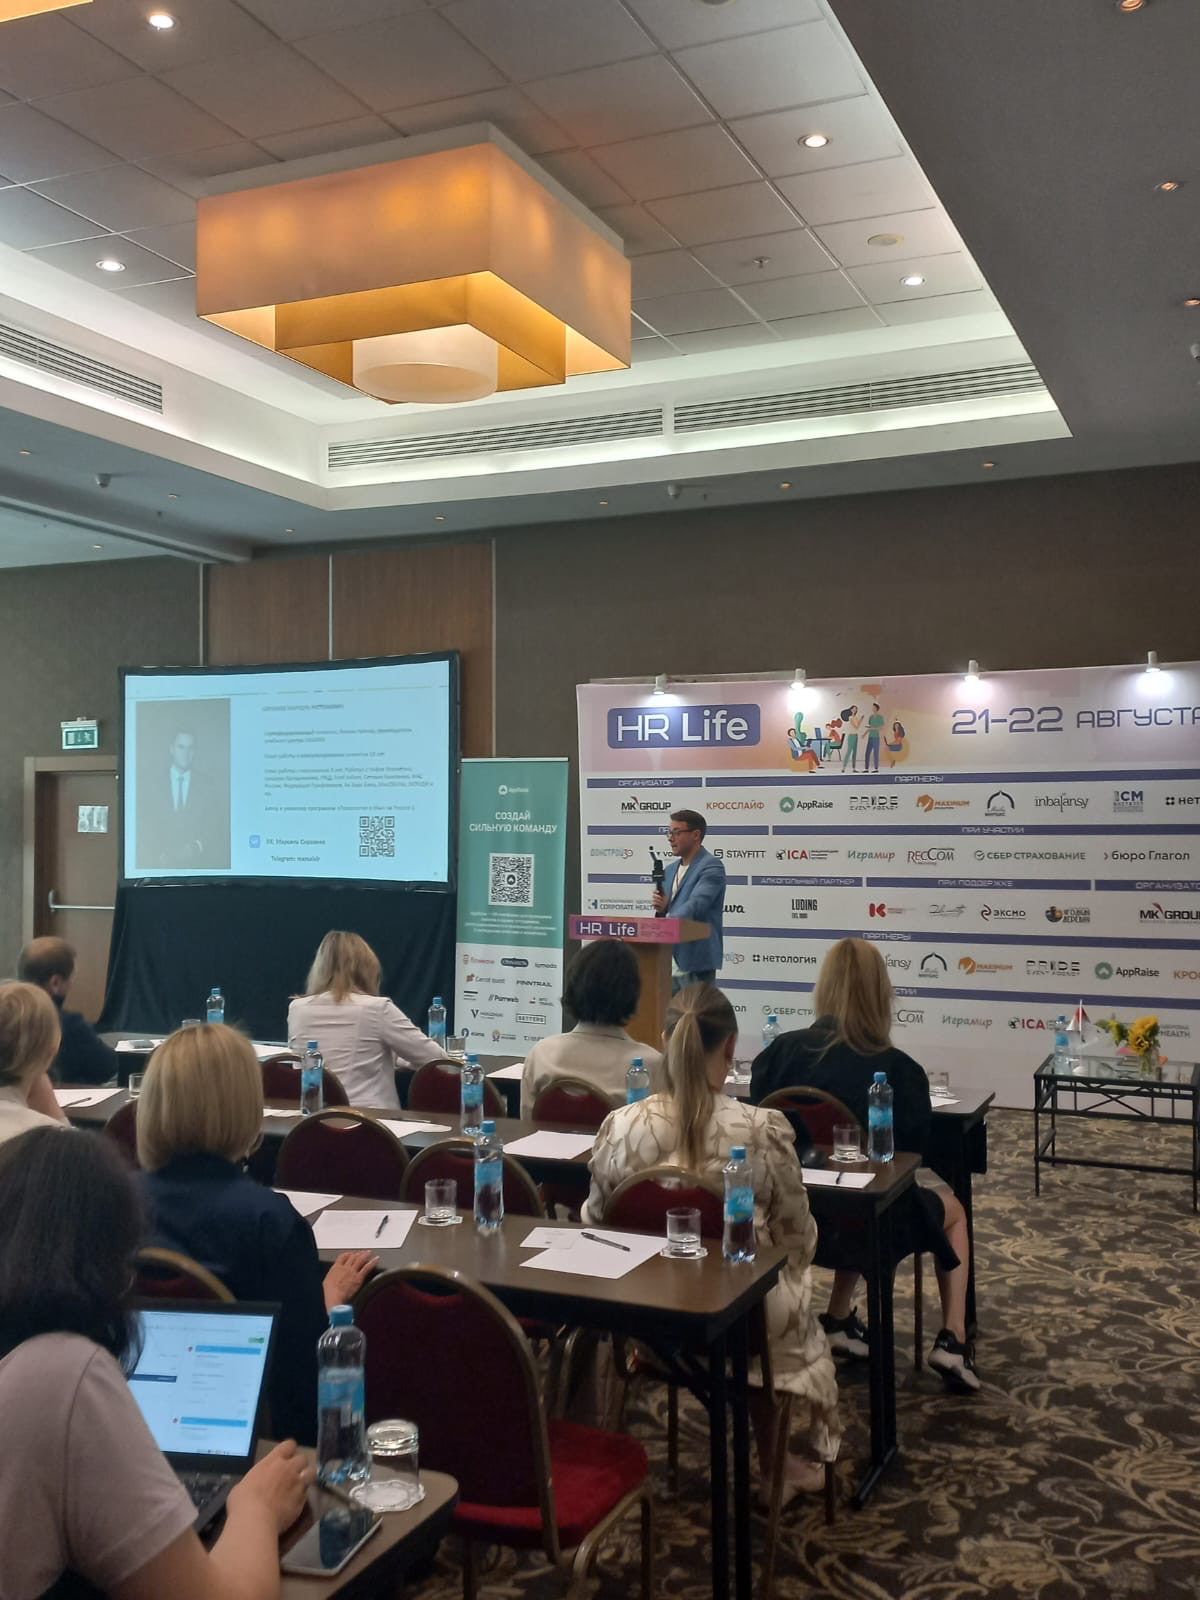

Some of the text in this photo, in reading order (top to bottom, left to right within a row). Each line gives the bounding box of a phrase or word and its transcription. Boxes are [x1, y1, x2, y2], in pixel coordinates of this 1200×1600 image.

[617, 709, 749, 742] HR Life
[952, 706, 1063, 734] 21-22
[894, 775, 944, 783] ПАРТНЕРЫ
[621, 802, 672, 811] MK GROUP
[706, 800, 765, 810] КРОССЛАЙФ
[797, 800, 834, 809] AppRaise
[495, 810, 531, 821] СОЗДАЙ
[469, 823, 558, 834] СИЛЬНУЮ КОМАНДУ
[726, 850, 766, 859] STAYFITT
[787, 850, 808, 860] ICA
[1112, 850, 1190, 862] бюро Глагол
[1136, 881, 1200, 890] ОРГАНИЗАТО
[791, 899, 818, 911] LUDING
[993, 909, 1026, 917] ЭКСМО
[1139, 909, 1200, 920] MK GROU
[580, 922, 602, 935] HR
[609, 923, 636, 936] Life
[762, 955, 817, 964] нетология
[1116, 967, 1160, 978] AppRaise
[1021, 1018, 1045, 1031] ICA
